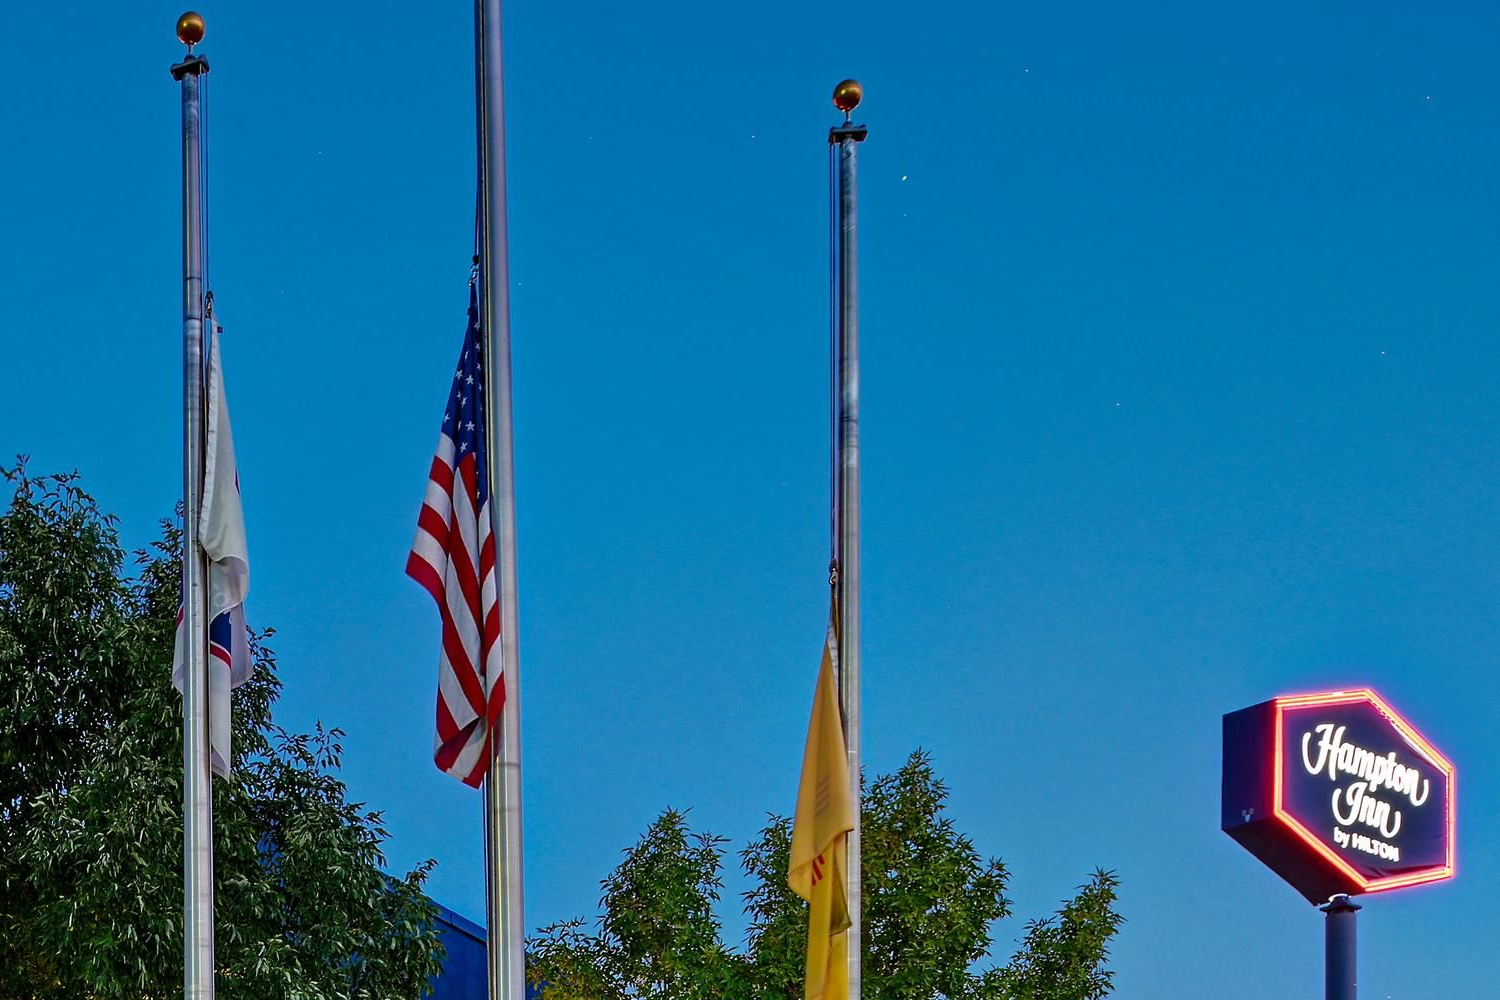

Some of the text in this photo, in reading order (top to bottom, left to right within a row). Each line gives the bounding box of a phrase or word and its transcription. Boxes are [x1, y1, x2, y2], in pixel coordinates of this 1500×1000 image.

[1302, 723, 1429, 807] Hampton
[1331, 781, 1402, 839] Inn
[1333, 826, 1400, 862] by HILTON
